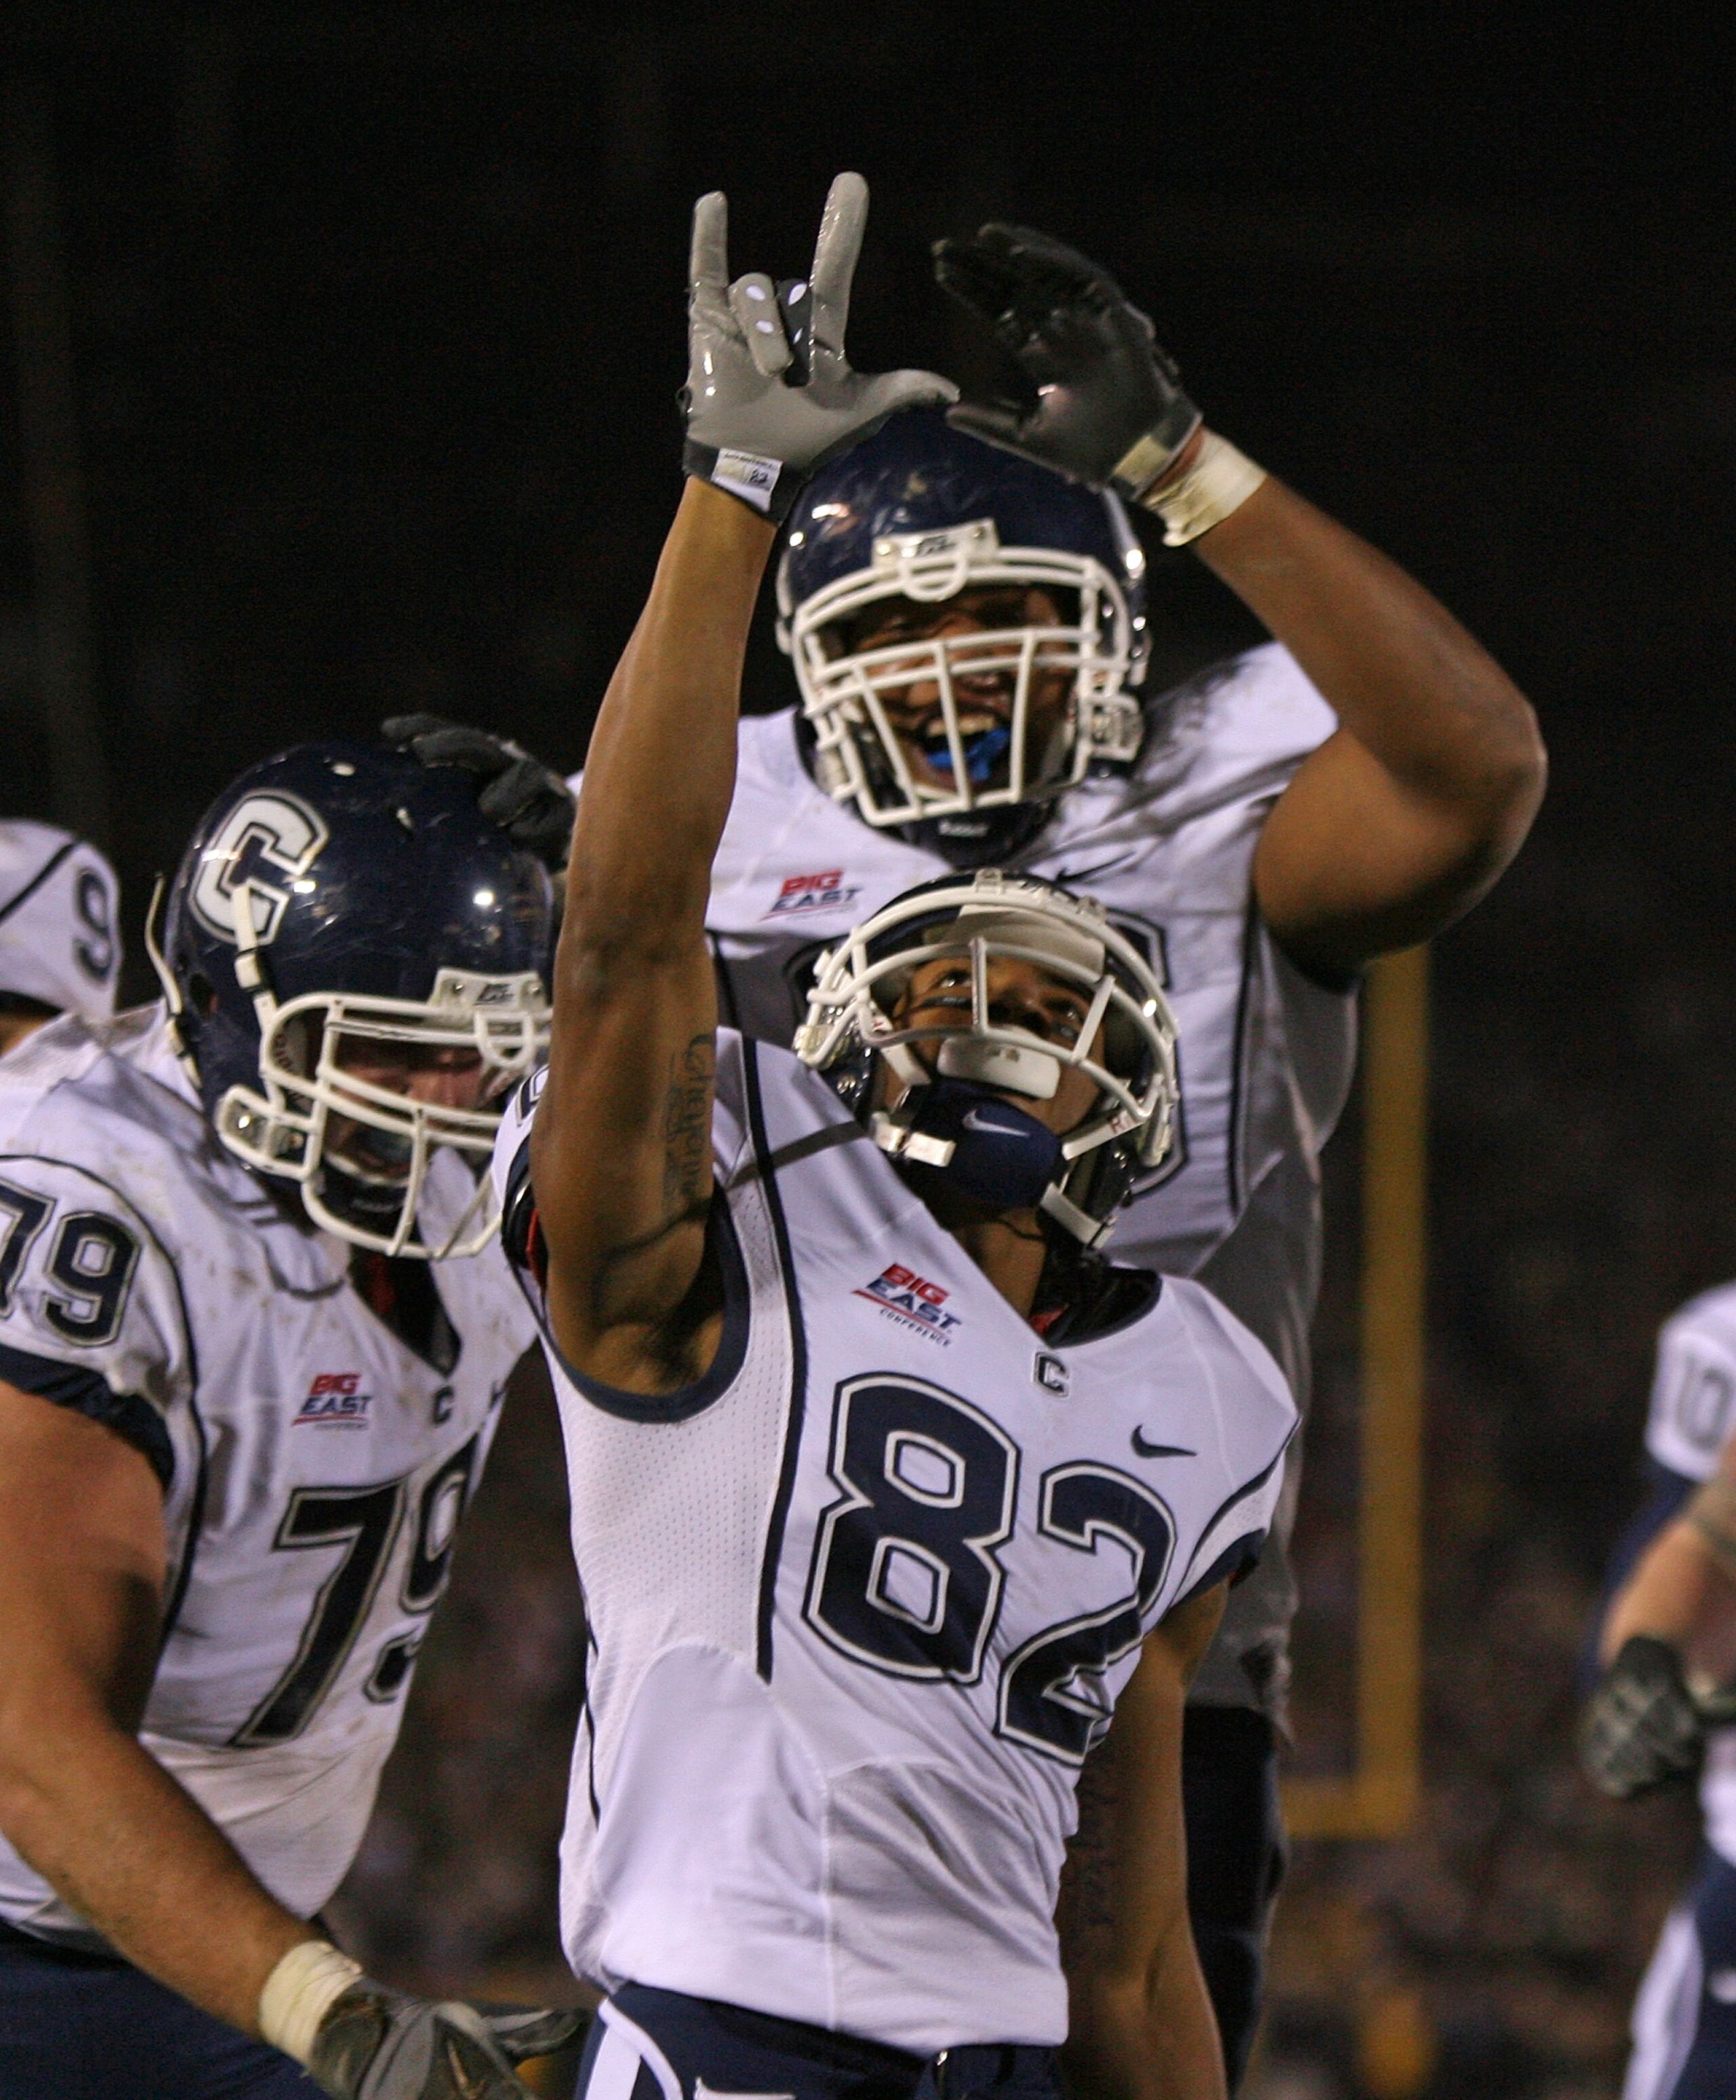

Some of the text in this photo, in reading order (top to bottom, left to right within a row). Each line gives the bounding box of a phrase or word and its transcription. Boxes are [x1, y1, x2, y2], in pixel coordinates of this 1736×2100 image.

[188, 787, 330, 946] C
[781, 868, 844, 897] BIG
[770, 887, 864, 912] EAST
[865, 1277, 962, 1329] EAST
[880, 1263, 949, 1306] BIG
[880, 1308, 953, 1347] CONFERENCE
[309, 1372, 362, 1396] BIG
[1033, 1351, 1070, 1398] C
[300, 1395, 372, 1415] EAST
[802, 1370, 1178, 1766] 82
